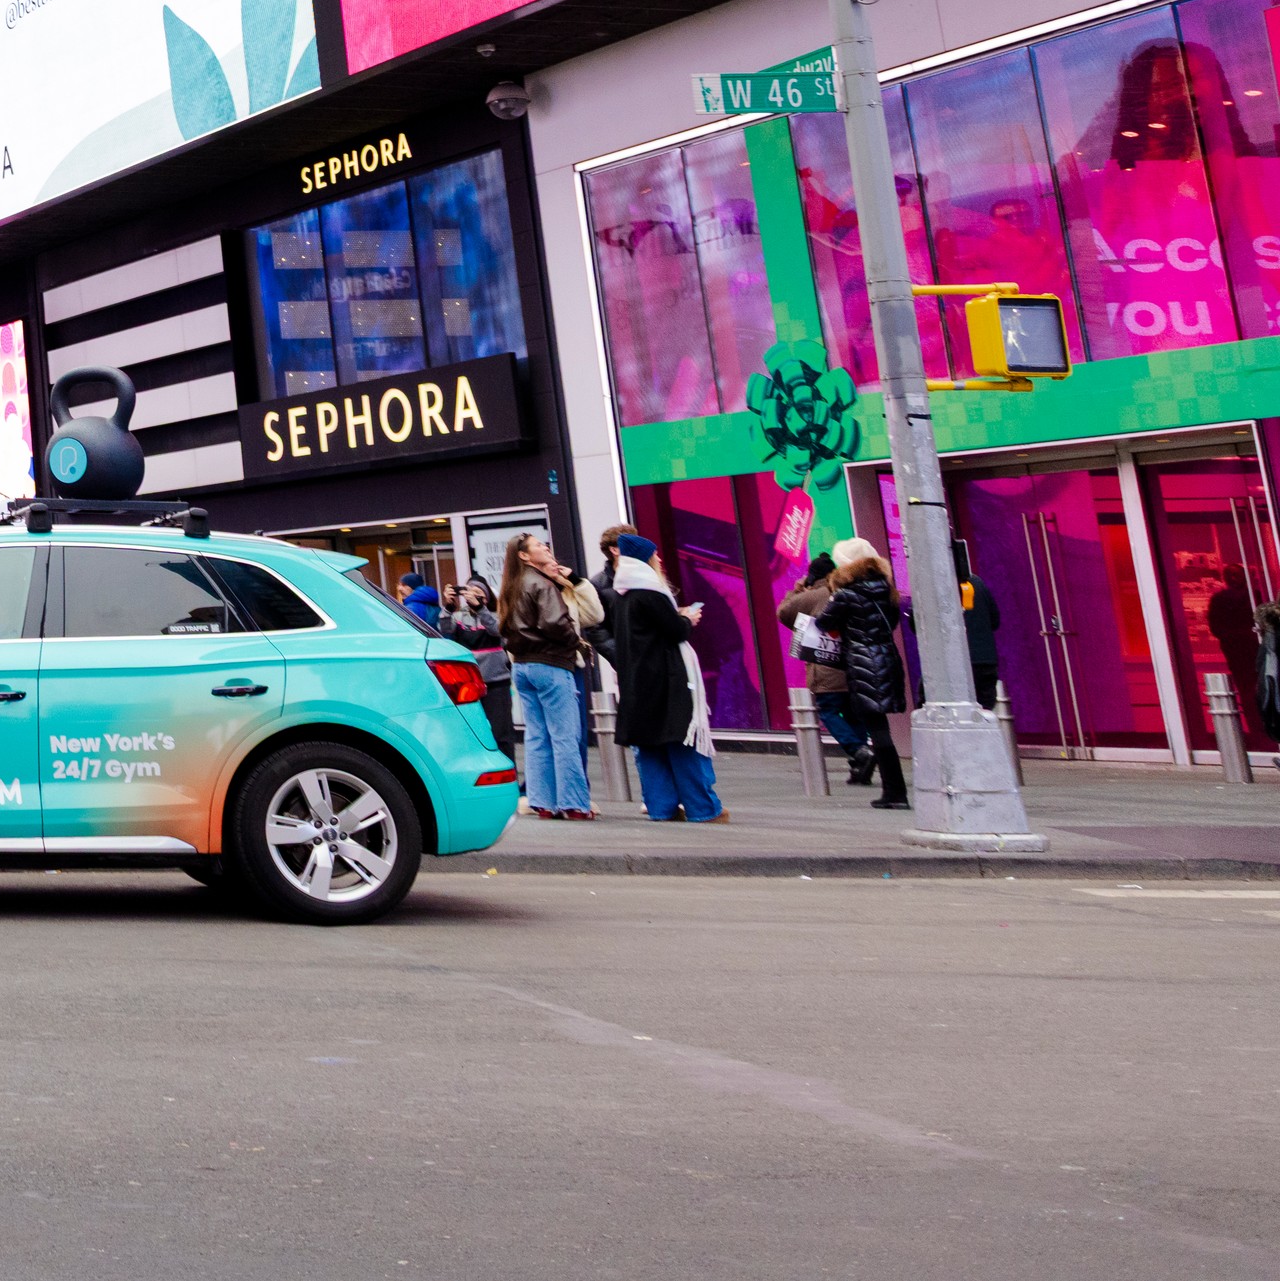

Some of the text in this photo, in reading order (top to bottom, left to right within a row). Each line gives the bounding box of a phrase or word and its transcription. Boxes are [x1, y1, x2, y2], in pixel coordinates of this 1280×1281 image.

[727, 77, 834, 109] W 46 St
[300, 133, 412, 195] SEPHORA
[263, 376, 484, 462] SEPHORA
[185, 624, 209, 632] TRAFFIC
[50, 731, 175, 753] New York's
[52, 759, 161, 783] 24/7 Gym
